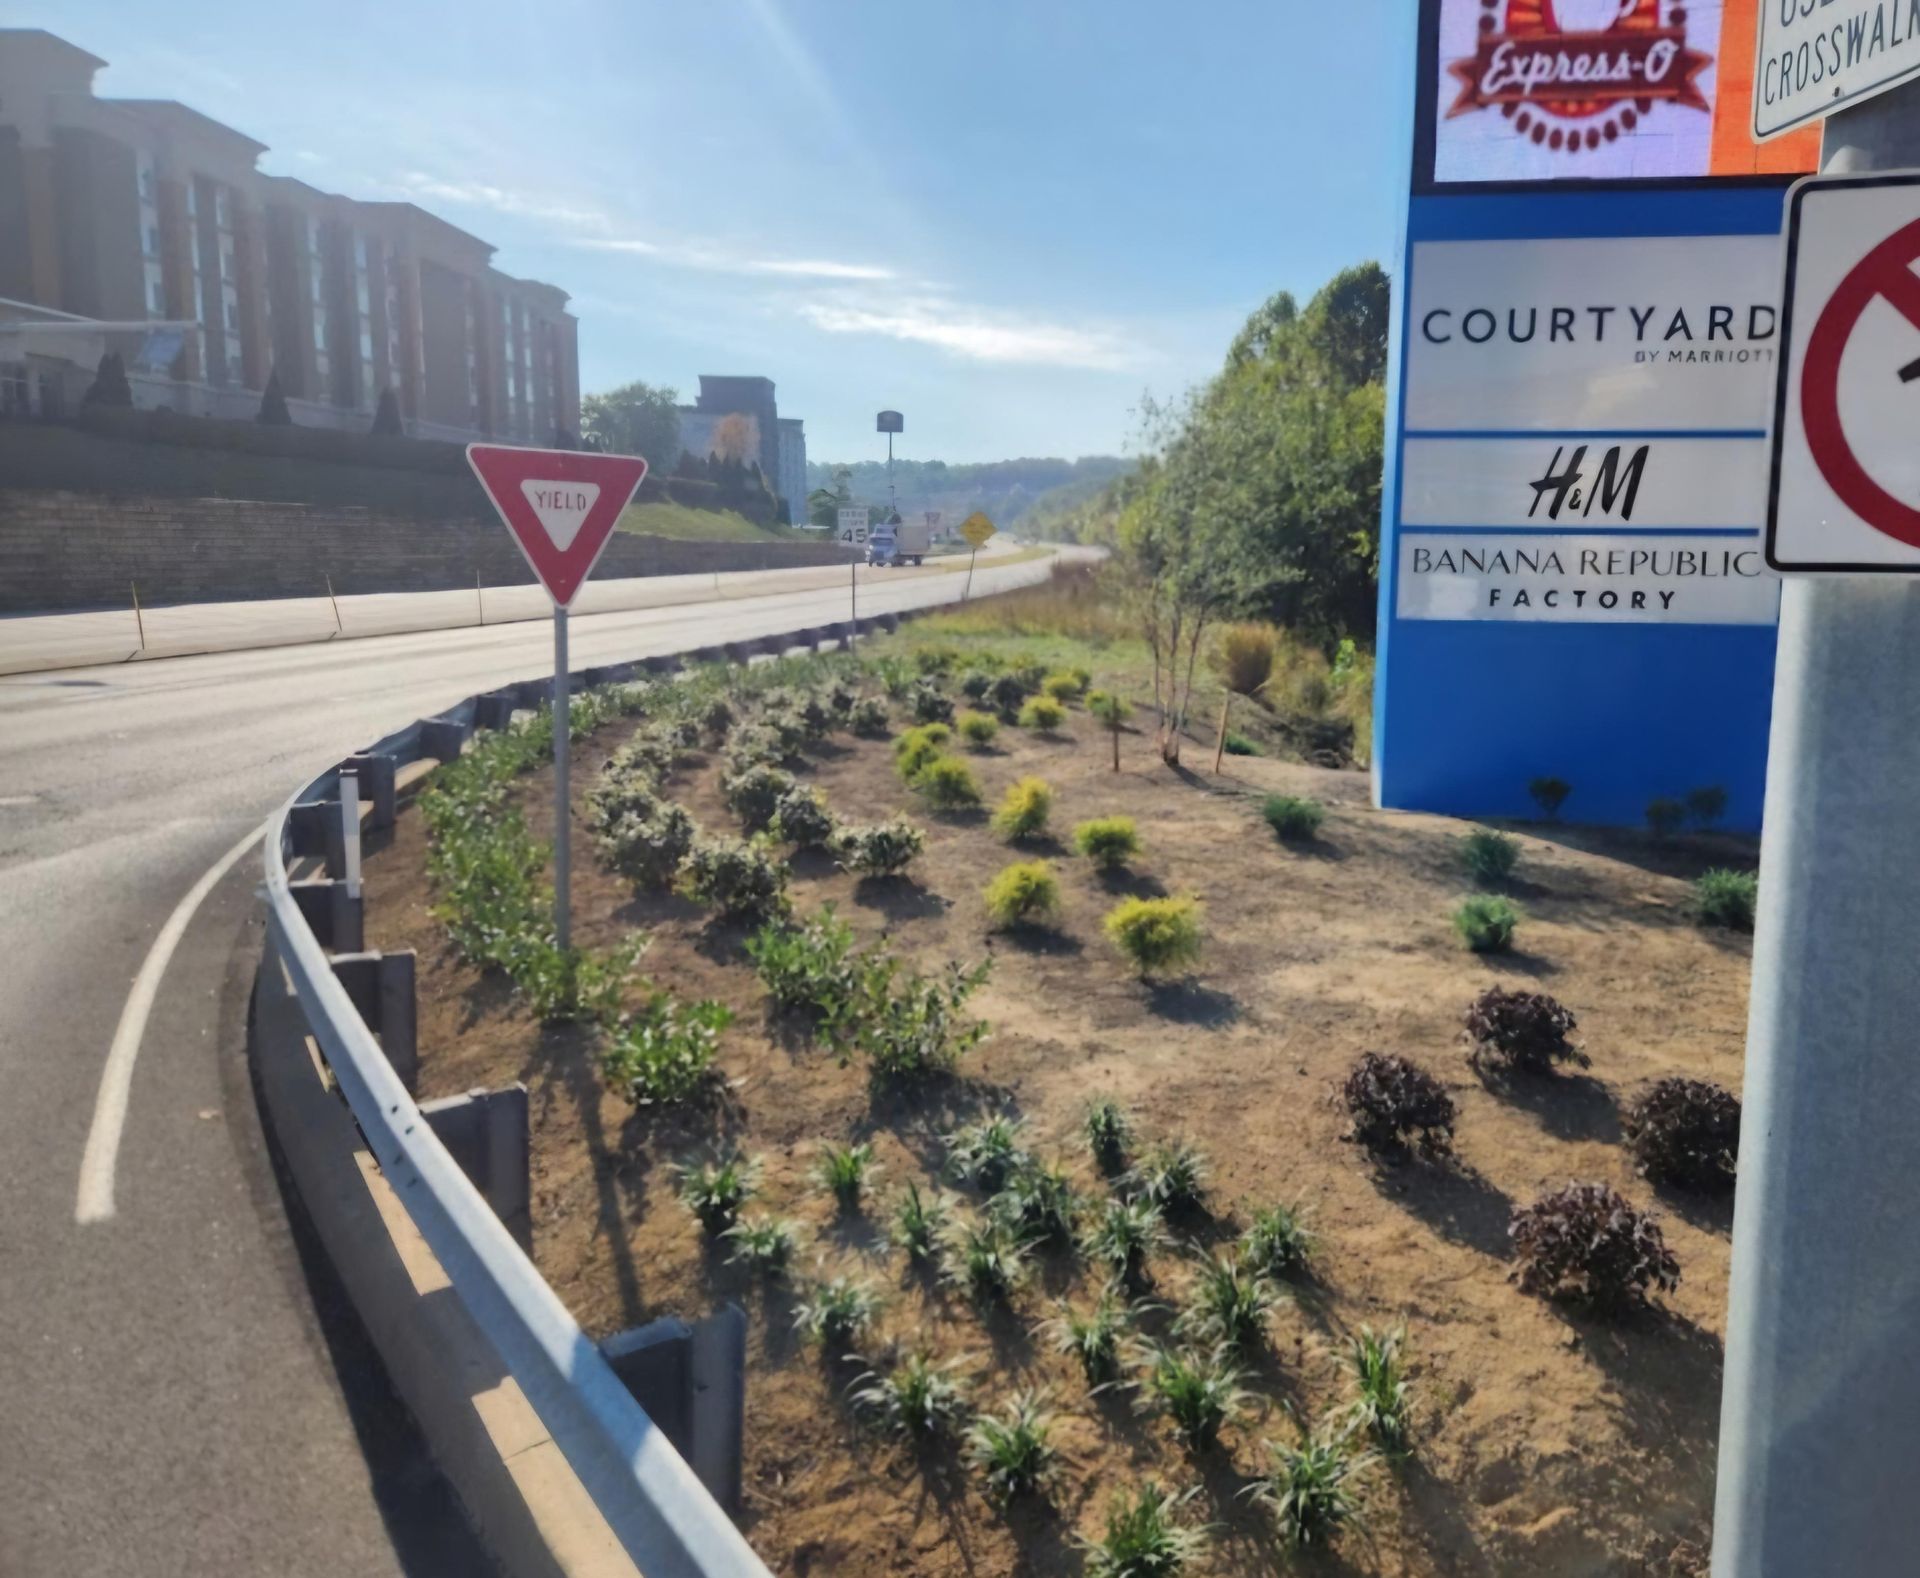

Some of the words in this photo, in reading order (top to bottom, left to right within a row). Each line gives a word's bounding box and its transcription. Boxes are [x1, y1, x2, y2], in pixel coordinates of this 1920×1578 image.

[1480, 38, 1679, 96] Express-O
[1422, 305, 1776, 344] COURTYARD
[1634, 350, 1660, 363] BY
[1528, 445, 1650, 521] H&M
[535, 491, 587, 511] YIELD
[841, 528, 866, 544] 45
[1413, 547, 1565, 575] BANANA
[1579, 549, 1762, 577] REPUBLIC
[1489, 589, 1676, 610] FACTORY
